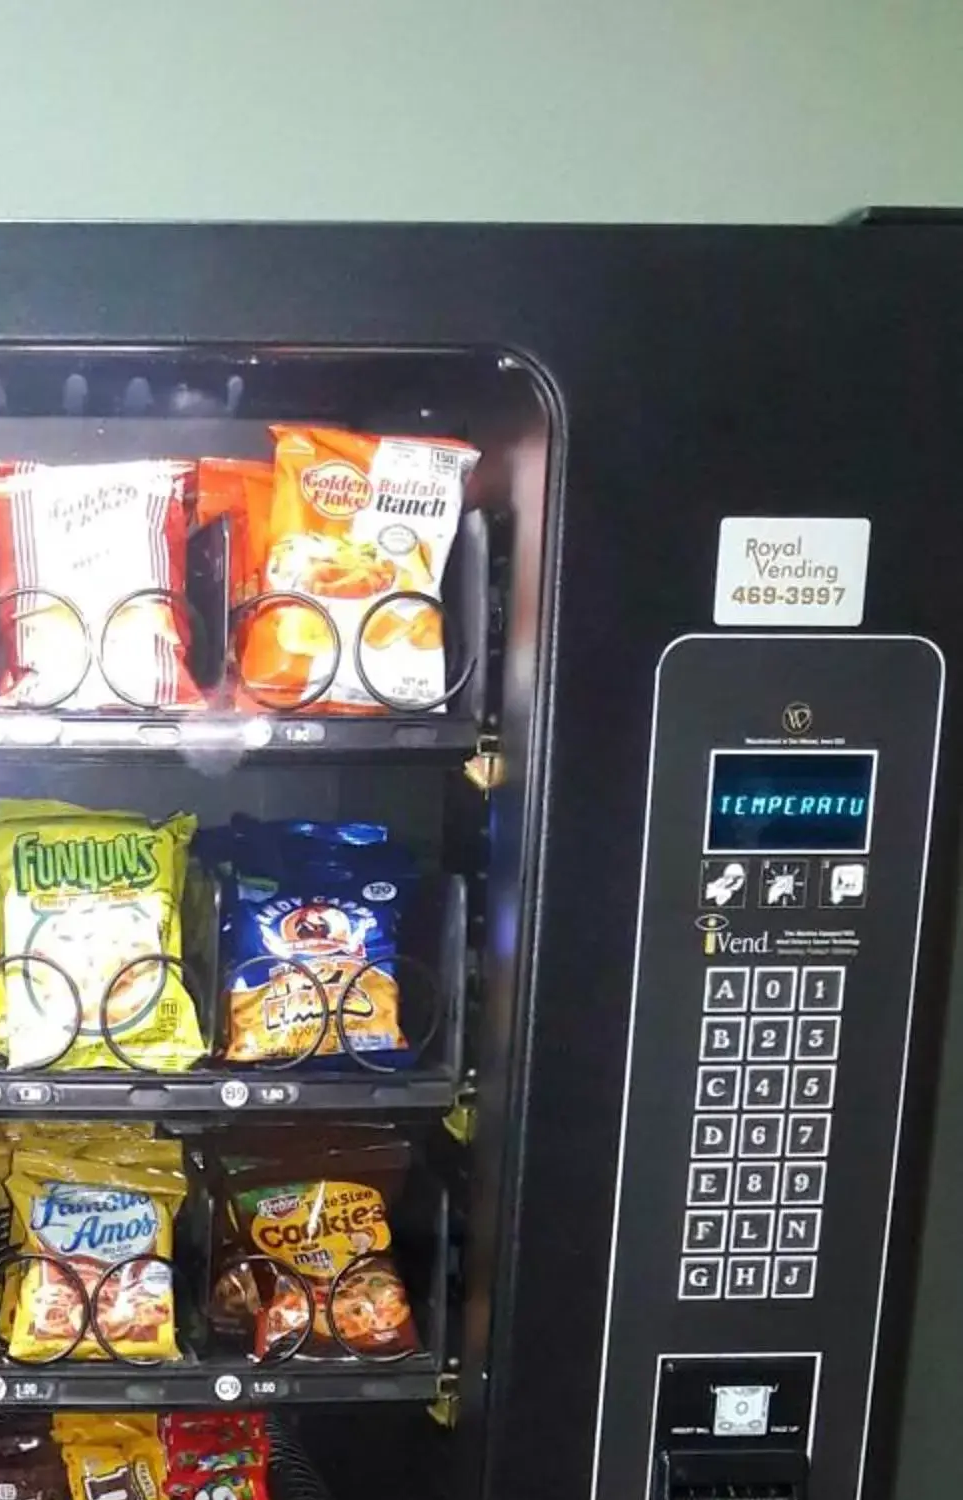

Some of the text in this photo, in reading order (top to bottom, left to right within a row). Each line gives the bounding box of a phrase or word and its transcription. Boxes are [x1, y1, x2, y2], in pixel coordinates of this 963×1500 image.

[303, 469, 369, 496] Golden
[377, 478, 447, 497] Buffalo
[312, 490, 367, 508] Flake
[375, 494, 447, 519] Ranch
[746, 537, 802, 559] Royal
[755, 560, 838, 582] Vending
[731, 586, 846, 606] 469-3997
[719, 795, 864, 817] TEMPERATU
[13, 832, 161, 897] FUNYUNS
[715, 979, 735, 999] A
[766, 980, 780, 998] 0
[815, 980, 826, 998] 1
[713, 1030, 730, 1049] B
[761, 1030, 776, 1047] 2
[810, 1030, 824, 1048] 3
[707, 1079, 726, 1097] C
[756, 1079, 770, 1097] 4
[804, 1078, 818, 1097] 5
[704, 1127, 723, 1145] D
[751, 1127, 766, 1144] 6
[799, 1126, 813, 1144] 7
[700, 1175, 717, 1193] E
[747, 1175, 762, 1192] 8
[795, 1175, 809, 1192] 9
[60, 1215, 159, 1253] Amos
[259, 1203, 384, 1248] Cookies
[696, 1221, 714, 1240] F
[742, 1221, 757, 1239] L
[788, 1220, 806, 1239] N
[689, 1268, 709, 1286] G
[737, 1267, 755, 1286] H
[785, 1267, 799, 1285] J
